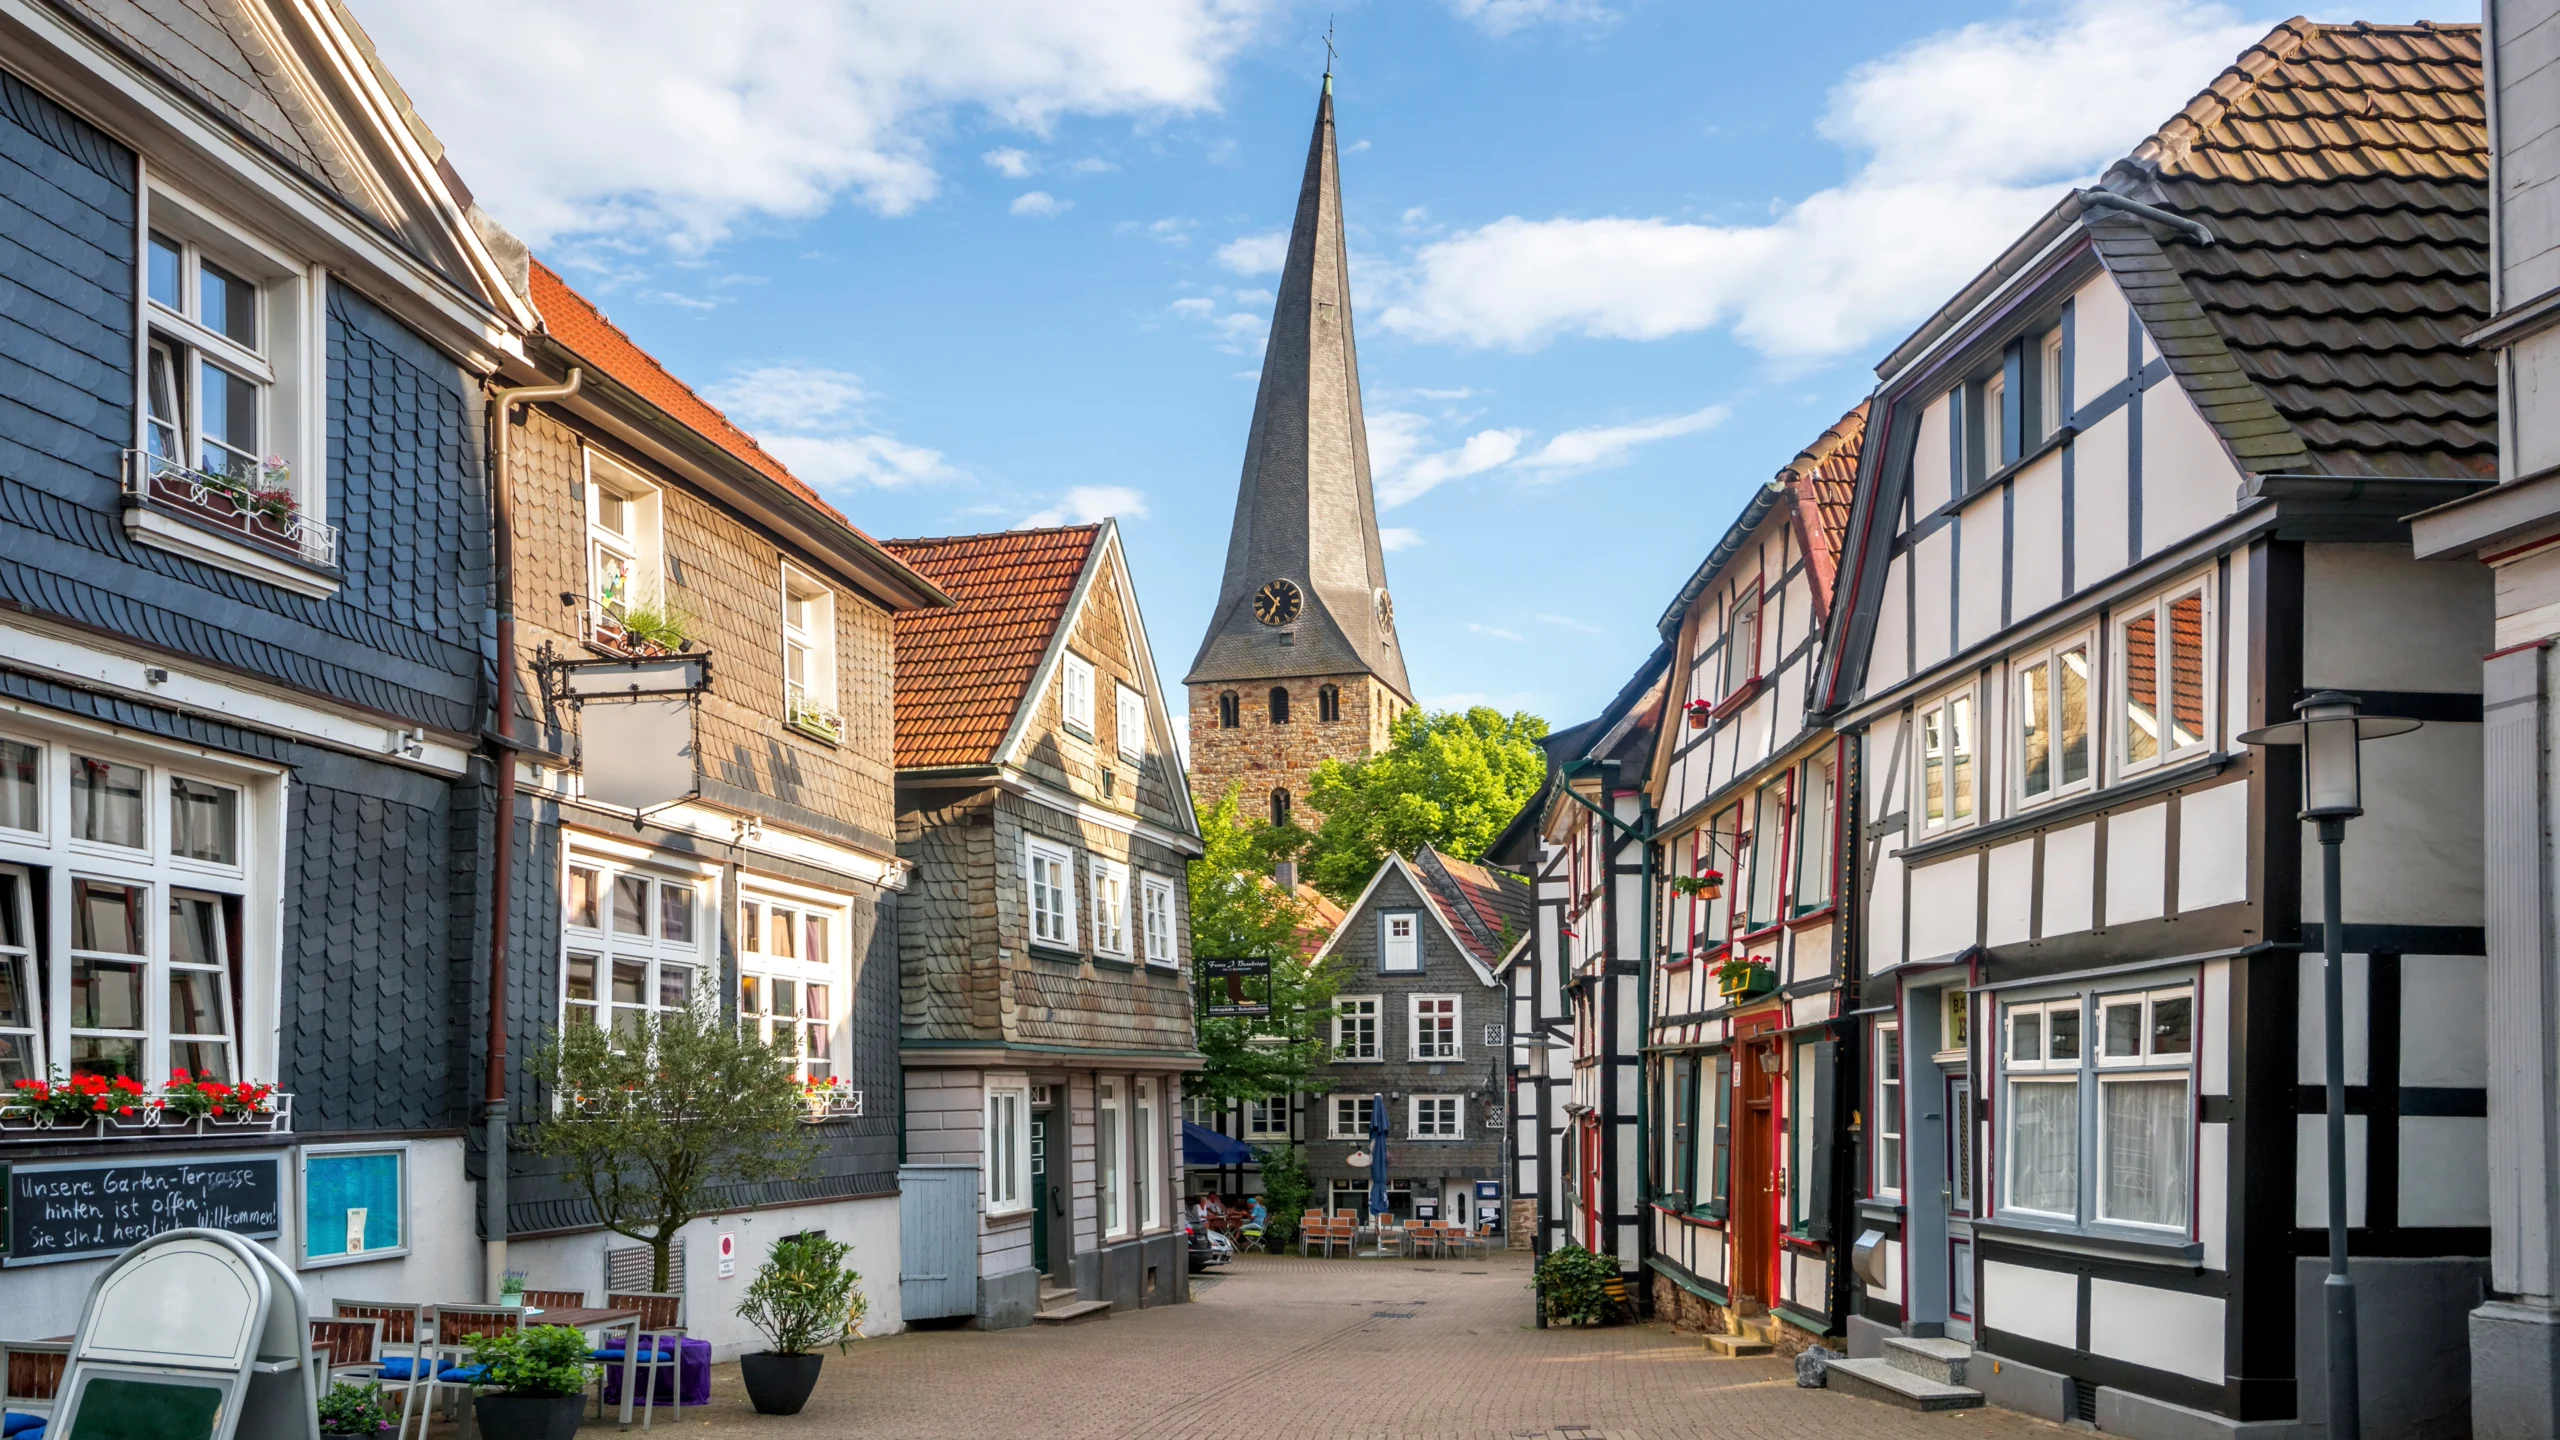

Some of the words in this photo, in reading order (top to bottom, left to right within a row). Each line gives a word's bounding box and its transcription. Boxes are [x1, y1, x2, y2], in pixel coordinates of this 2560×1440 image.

[21, 1177, 95, 1198] Unsere
[103, 1166, 256, 1193] Garten-Terrasse
[45, 1198, 104, 1220] hinten
[115, 1197, 139, 1218] ist
[151, 1185, 207, 1217] offen!
[29, 1225, 57, 1248] Sie
[64, 1223, 105, 1248] sind
[113, 1215, 184, 1240] herzlich
[197, 1201, 278, 1229] Willkommen!
